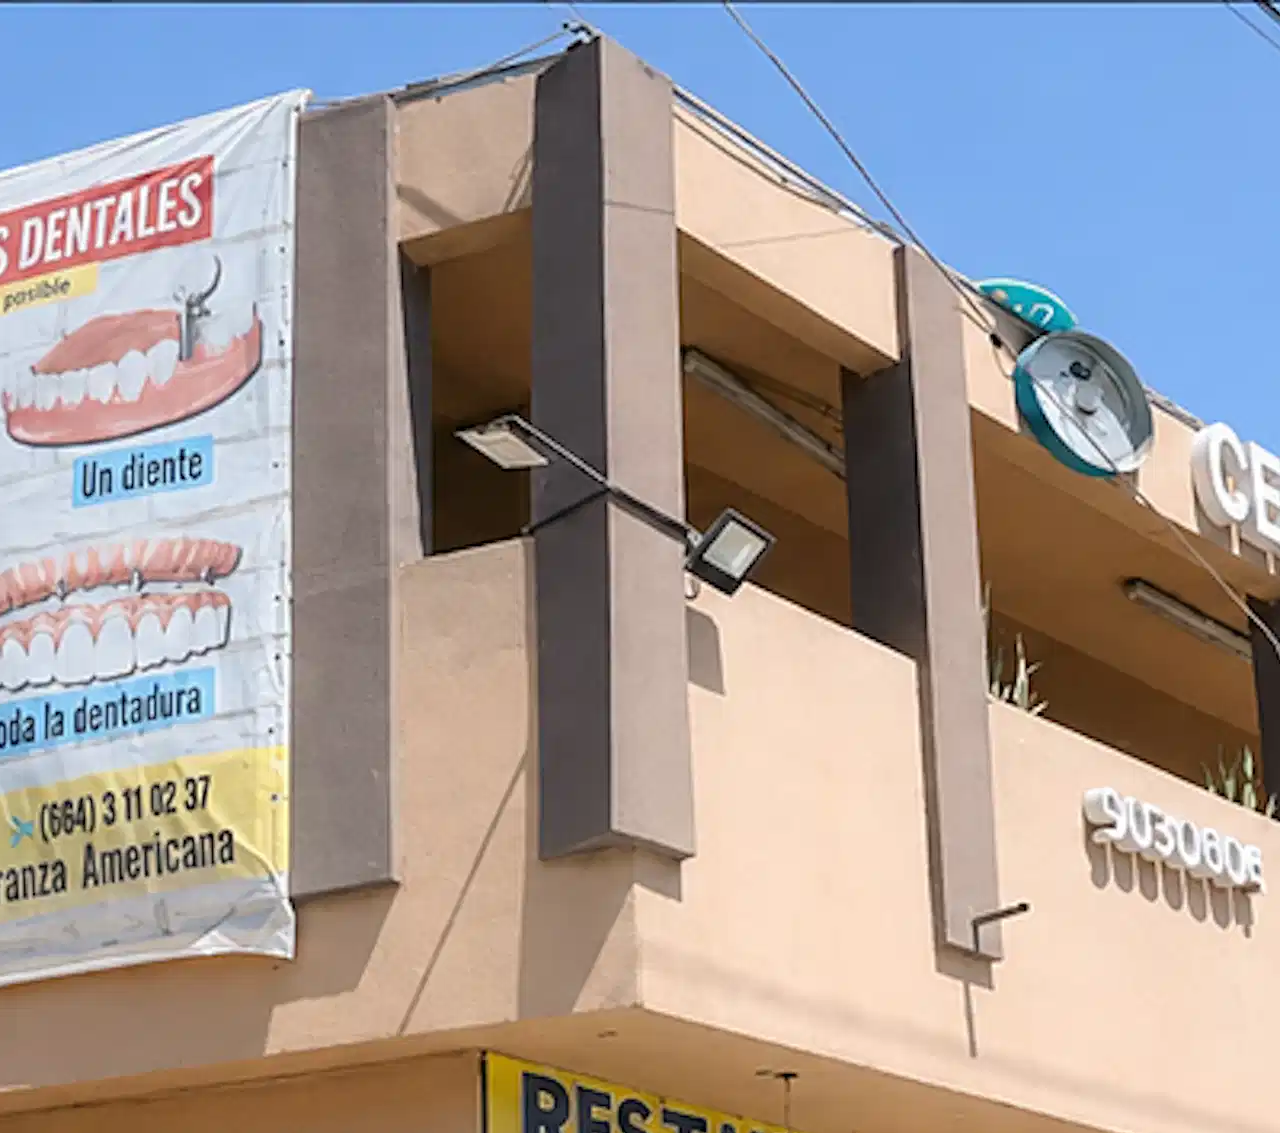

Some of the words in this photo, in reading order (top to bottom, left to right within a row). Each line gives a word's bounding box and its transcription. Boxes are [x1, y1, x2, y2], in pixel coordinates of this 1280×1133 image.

[19, 172, 204, 269] DENTALES
[3, 277, 71, 312] posible
[81, 463, 112, 499] Un
[122, 447, 204, 491] diente
[44, 703, 67, 740] la
[74, 682, 203, 733] dentadura
[40, 794, 96, 843] (664)
[102, 791, 116, 825] 3
[121, 785, 142, 821] 11
[150, 782, 176, 816] 02
[184, 775, 212, 810] 37
[82, 829, 235, 889] Americana
